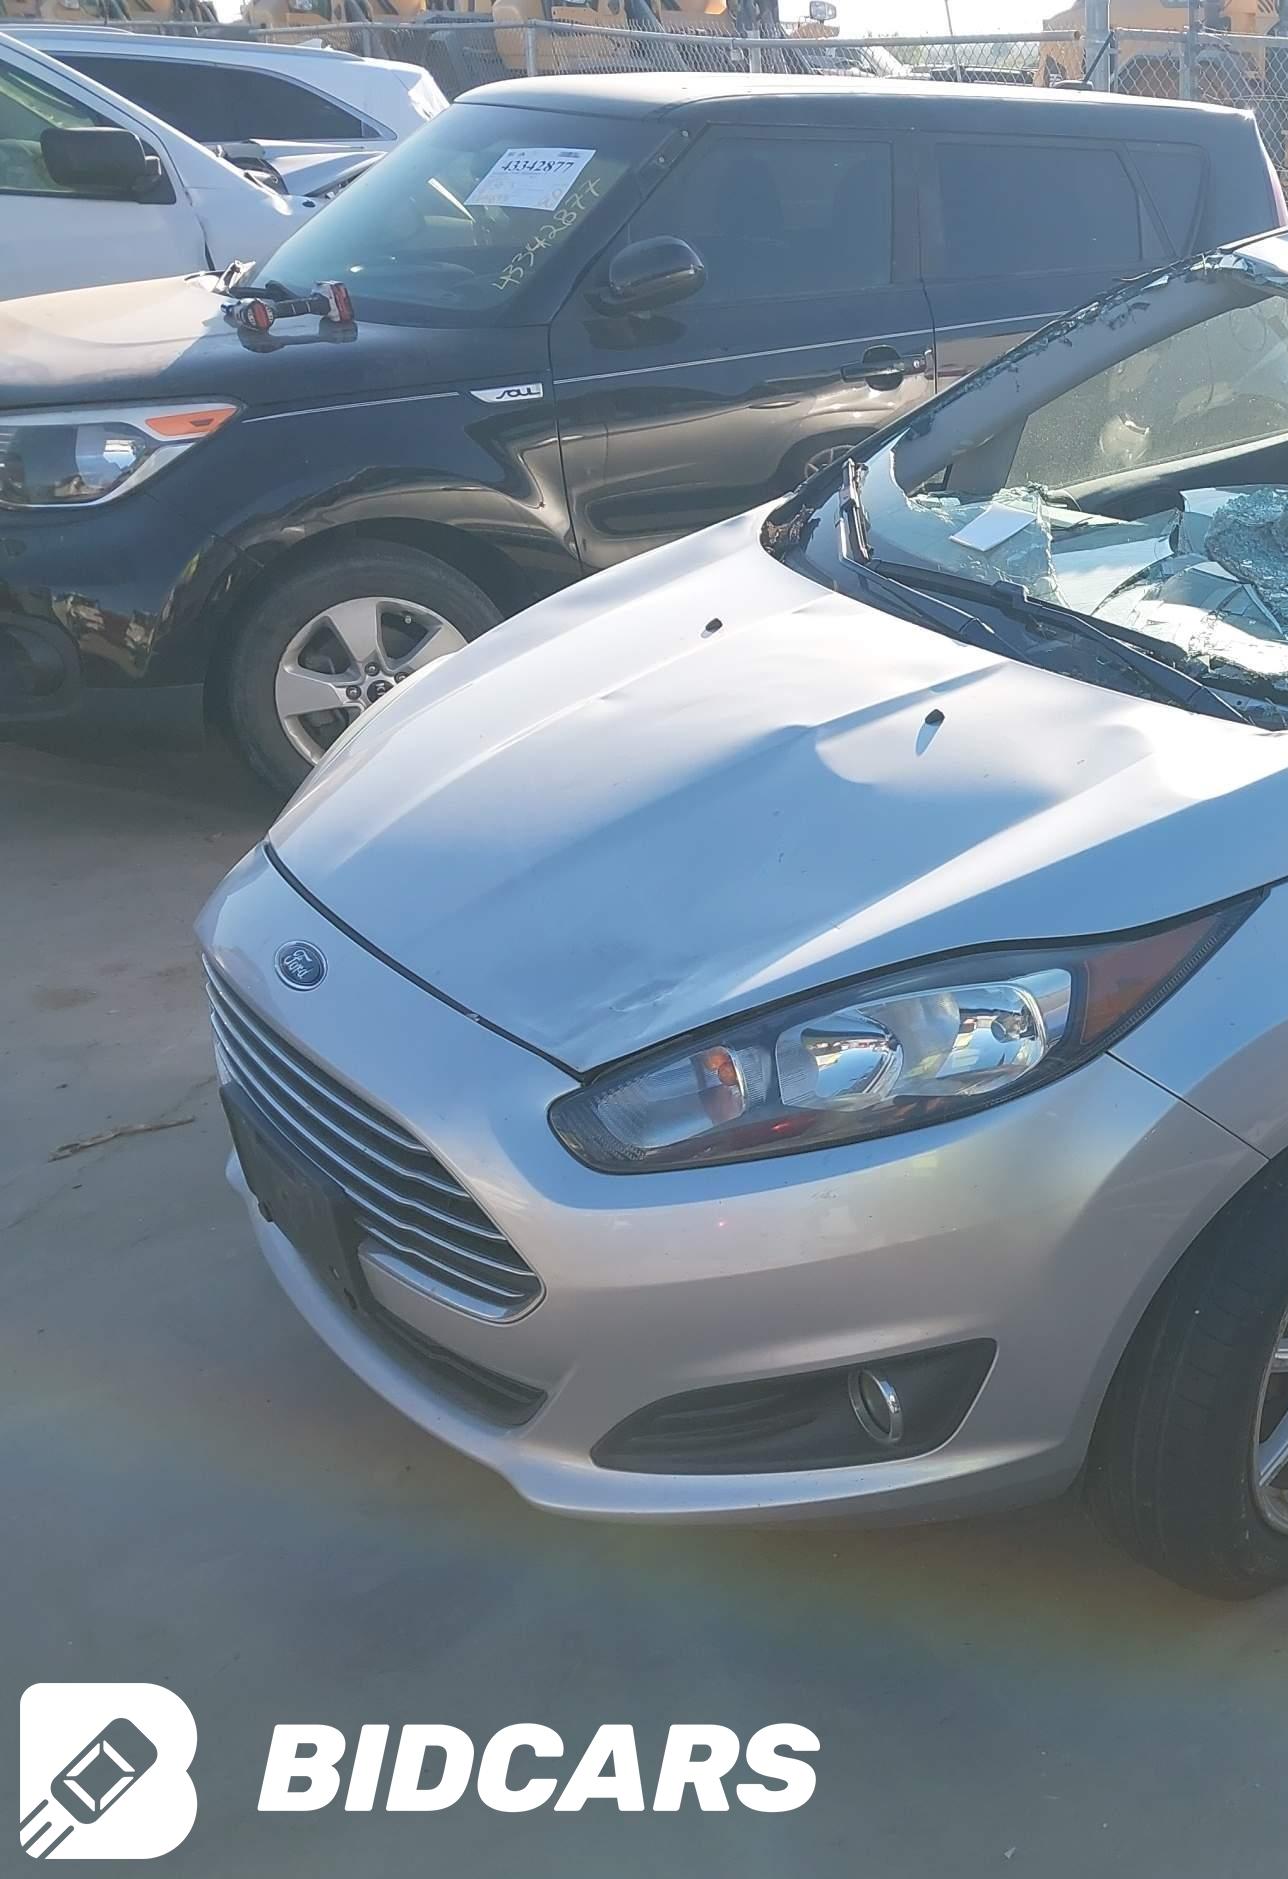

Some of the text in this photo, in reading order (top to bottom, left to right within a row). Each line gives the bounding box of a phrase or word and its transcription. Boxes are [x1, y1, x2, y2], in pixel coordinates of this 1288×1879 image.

[501, 159, 575, 173] 43342877
[491, 177, 601, 290] 43342877
[283, 949, 314, 980] Ford
